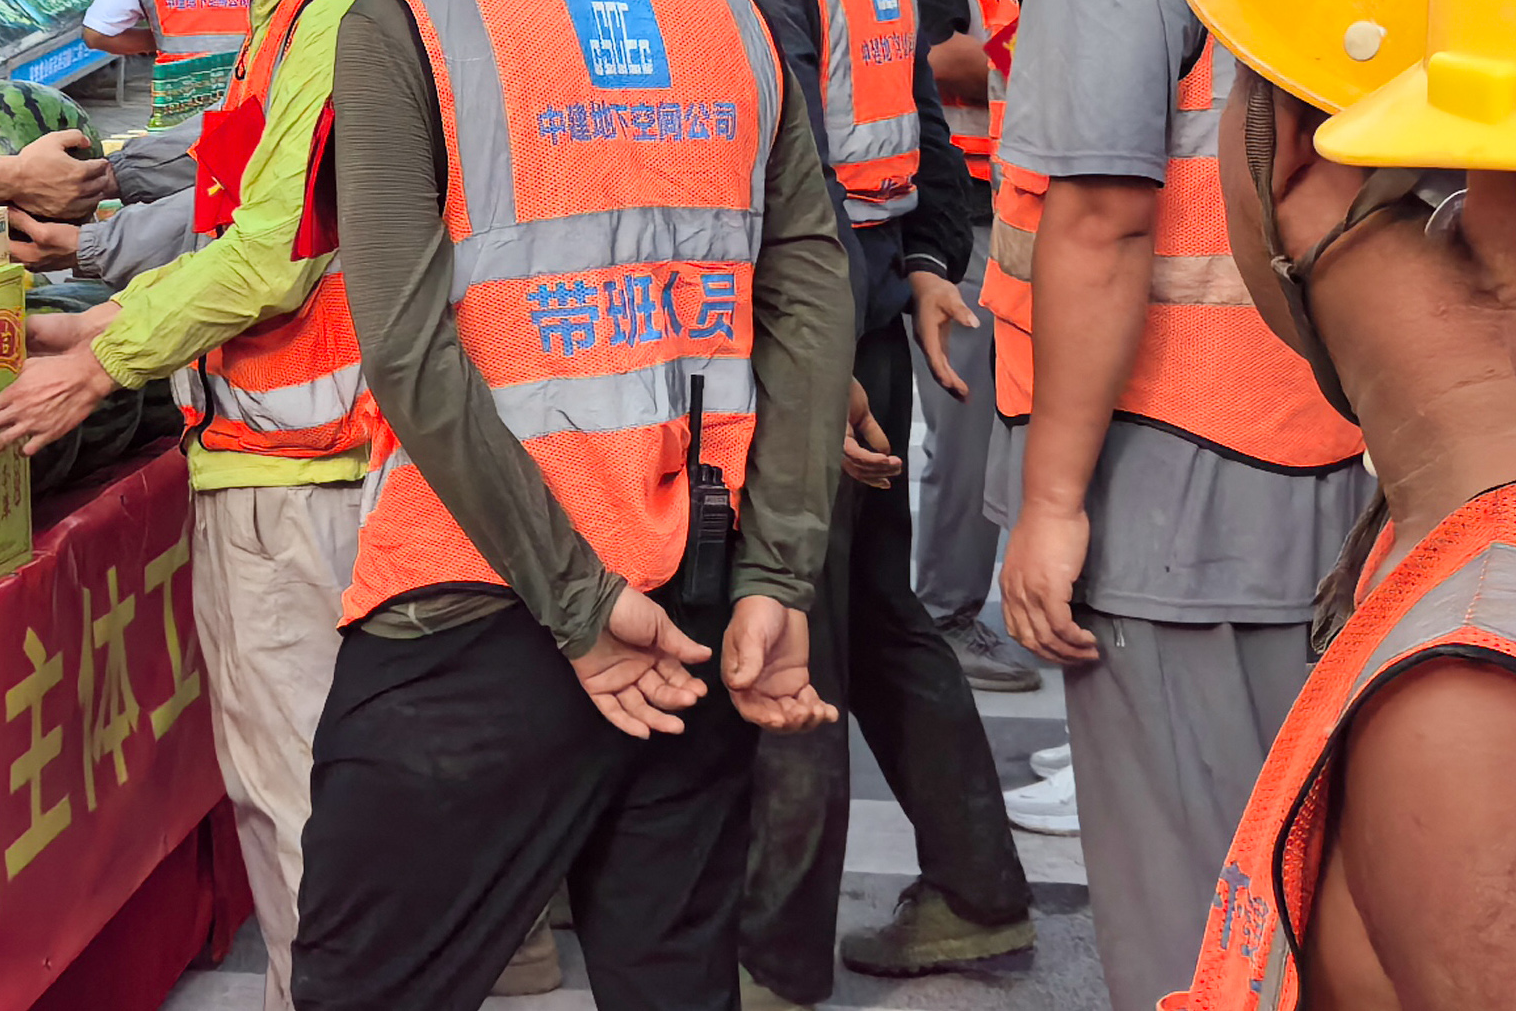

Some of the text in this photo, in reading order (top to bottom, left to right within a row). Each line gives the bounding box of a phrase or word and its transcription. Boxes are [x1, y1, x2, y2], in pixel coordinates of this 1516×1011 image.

[537, 101, 737, 146] 中建地下空间公司
[526, 271, 736, 356] 带班人员
